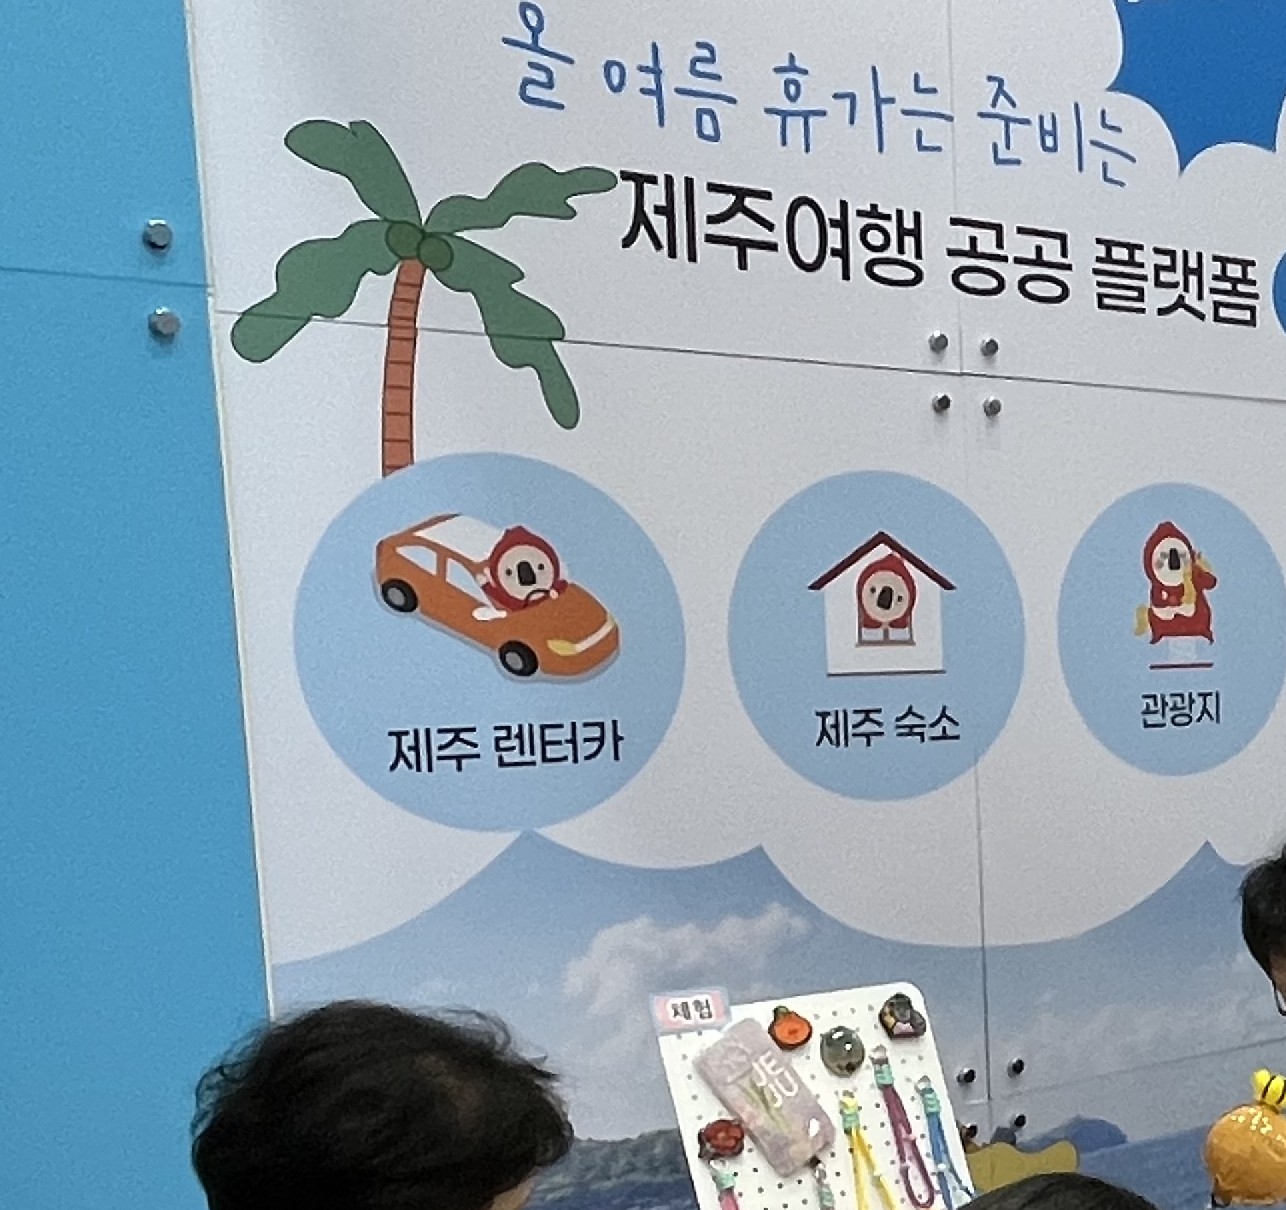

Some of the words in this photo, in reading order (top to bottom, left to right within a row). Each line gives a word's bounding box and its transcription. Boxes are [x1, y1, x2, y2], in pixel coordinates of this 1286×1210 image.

[502, 2, 575, 109] 올
[603, 42, 737, 142] 여름
[764, 53, 954, 153] 휴가는
[977, 75, 1137, 188] 준비는
[619, 170, 925, 289] 제주여행
[946, 217, 1073, 304] 공공
[1092, 237, 1261, 328] 플랫폼
[815, 707, 886, 749] 제주
[894, 704, 962, 744] 숙소
[1140, 690, 1222, 730] 관광지
[388, 726, 482, 774] 제주
[493, 718, 625, 769] 렌터카
[670, 999, 714, 1021] 체험
